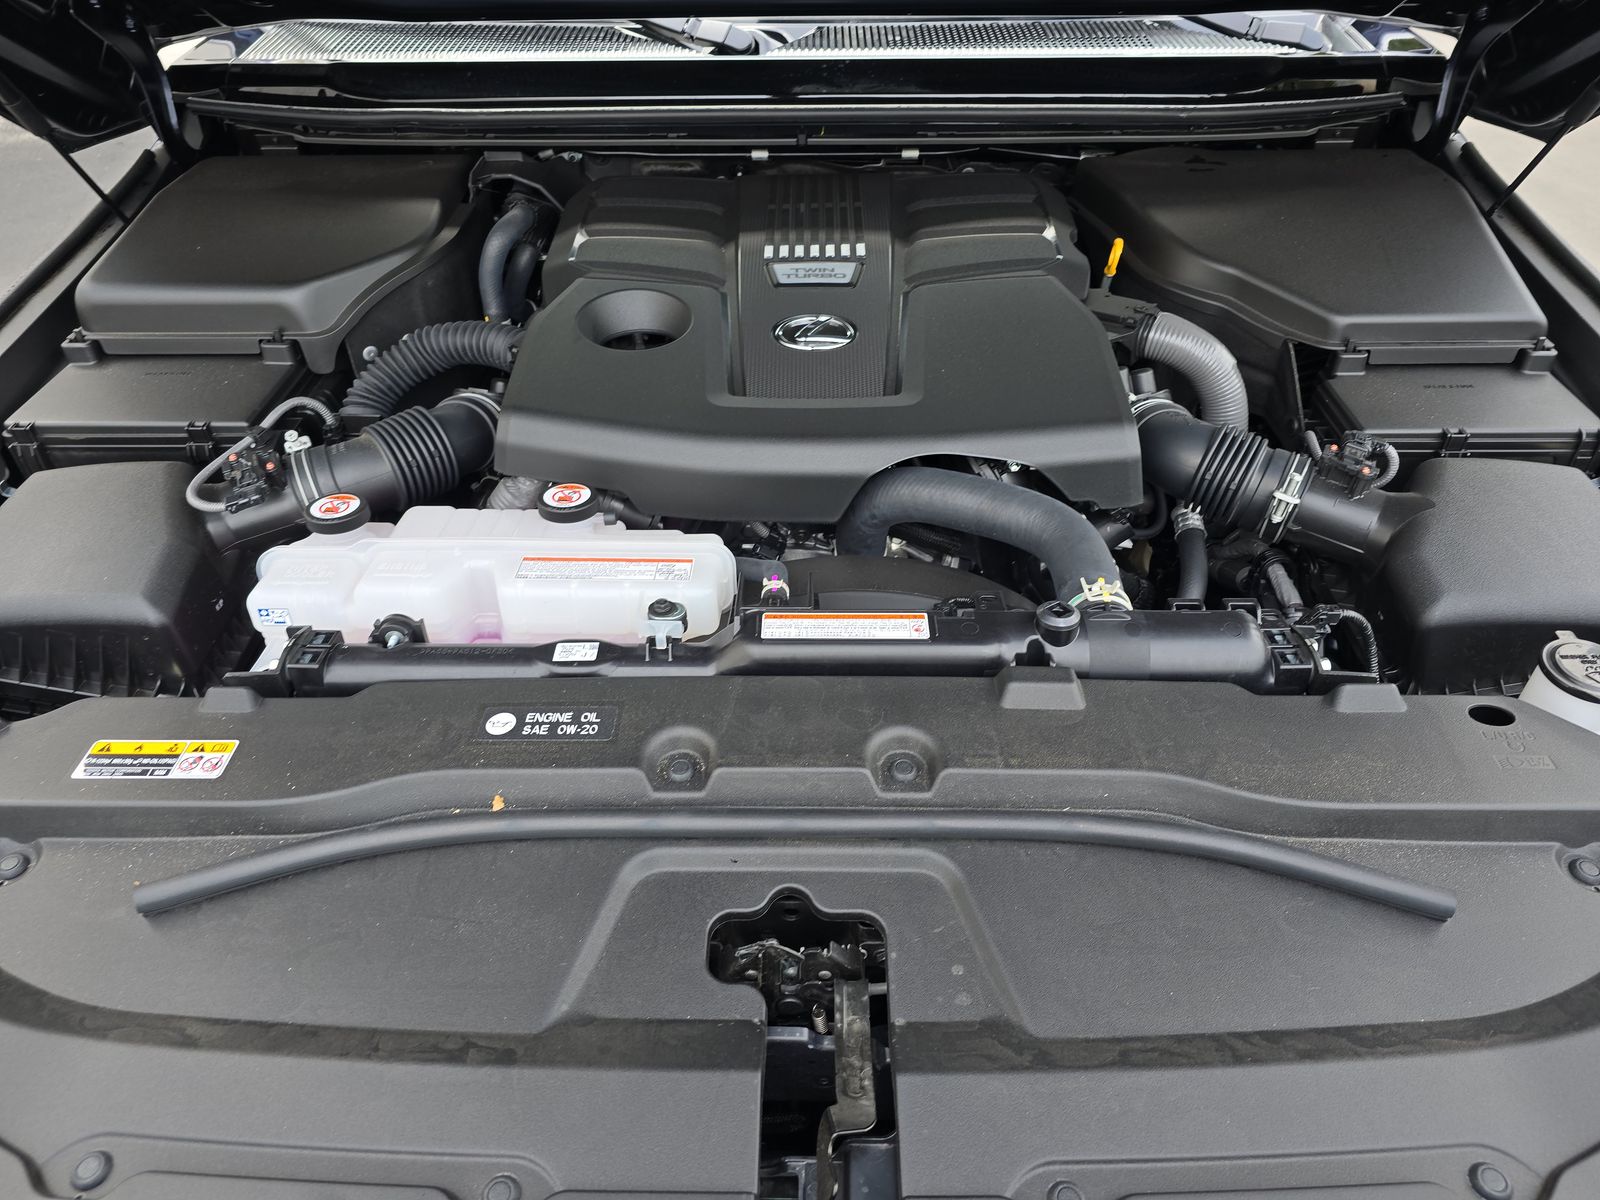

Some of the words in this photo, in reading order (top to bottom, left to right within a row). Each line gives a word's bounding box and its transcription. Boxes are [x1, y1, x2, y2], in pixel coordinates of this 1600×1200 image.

[781, 272, 848, 280] TURBO
[524, 711, 574, 723] ENGINE
[580, 711, 602, 722] OIL
[521, 724, 551, 735] SAE
